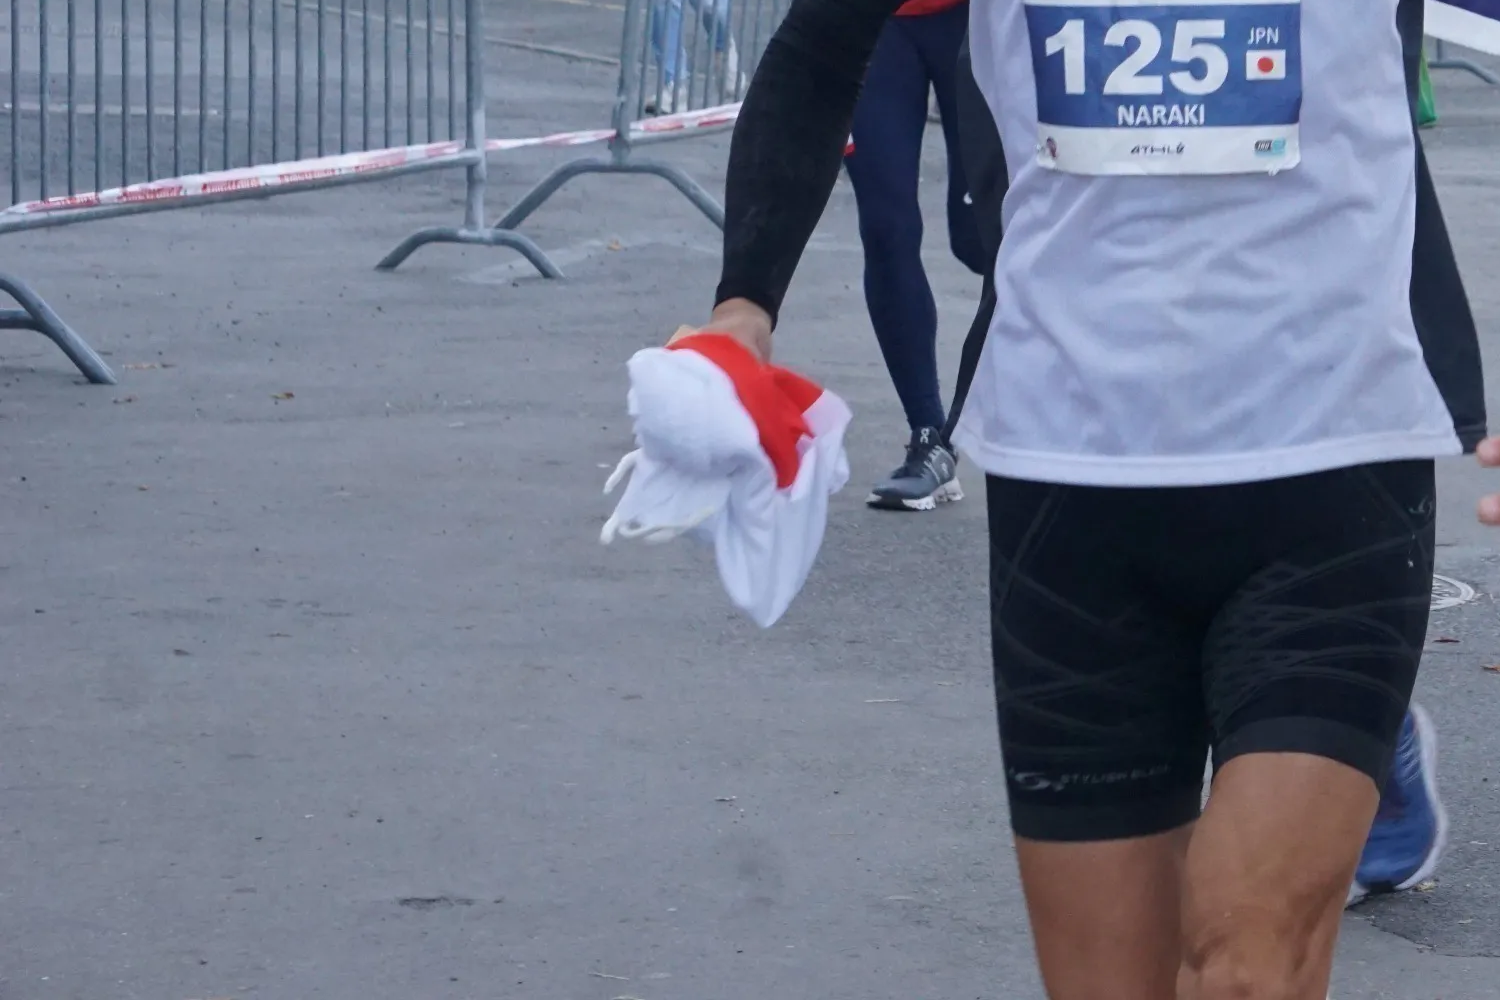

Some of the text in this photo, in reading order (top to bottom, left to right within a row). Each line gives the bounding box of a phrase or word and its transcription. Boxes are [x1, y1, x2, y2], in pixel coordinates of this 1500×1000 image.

[1248, 26, 1280, 45] JPN
[1045, 18, 1229, 96] 125
[1117, 103, 1206, 127] NARAKI
